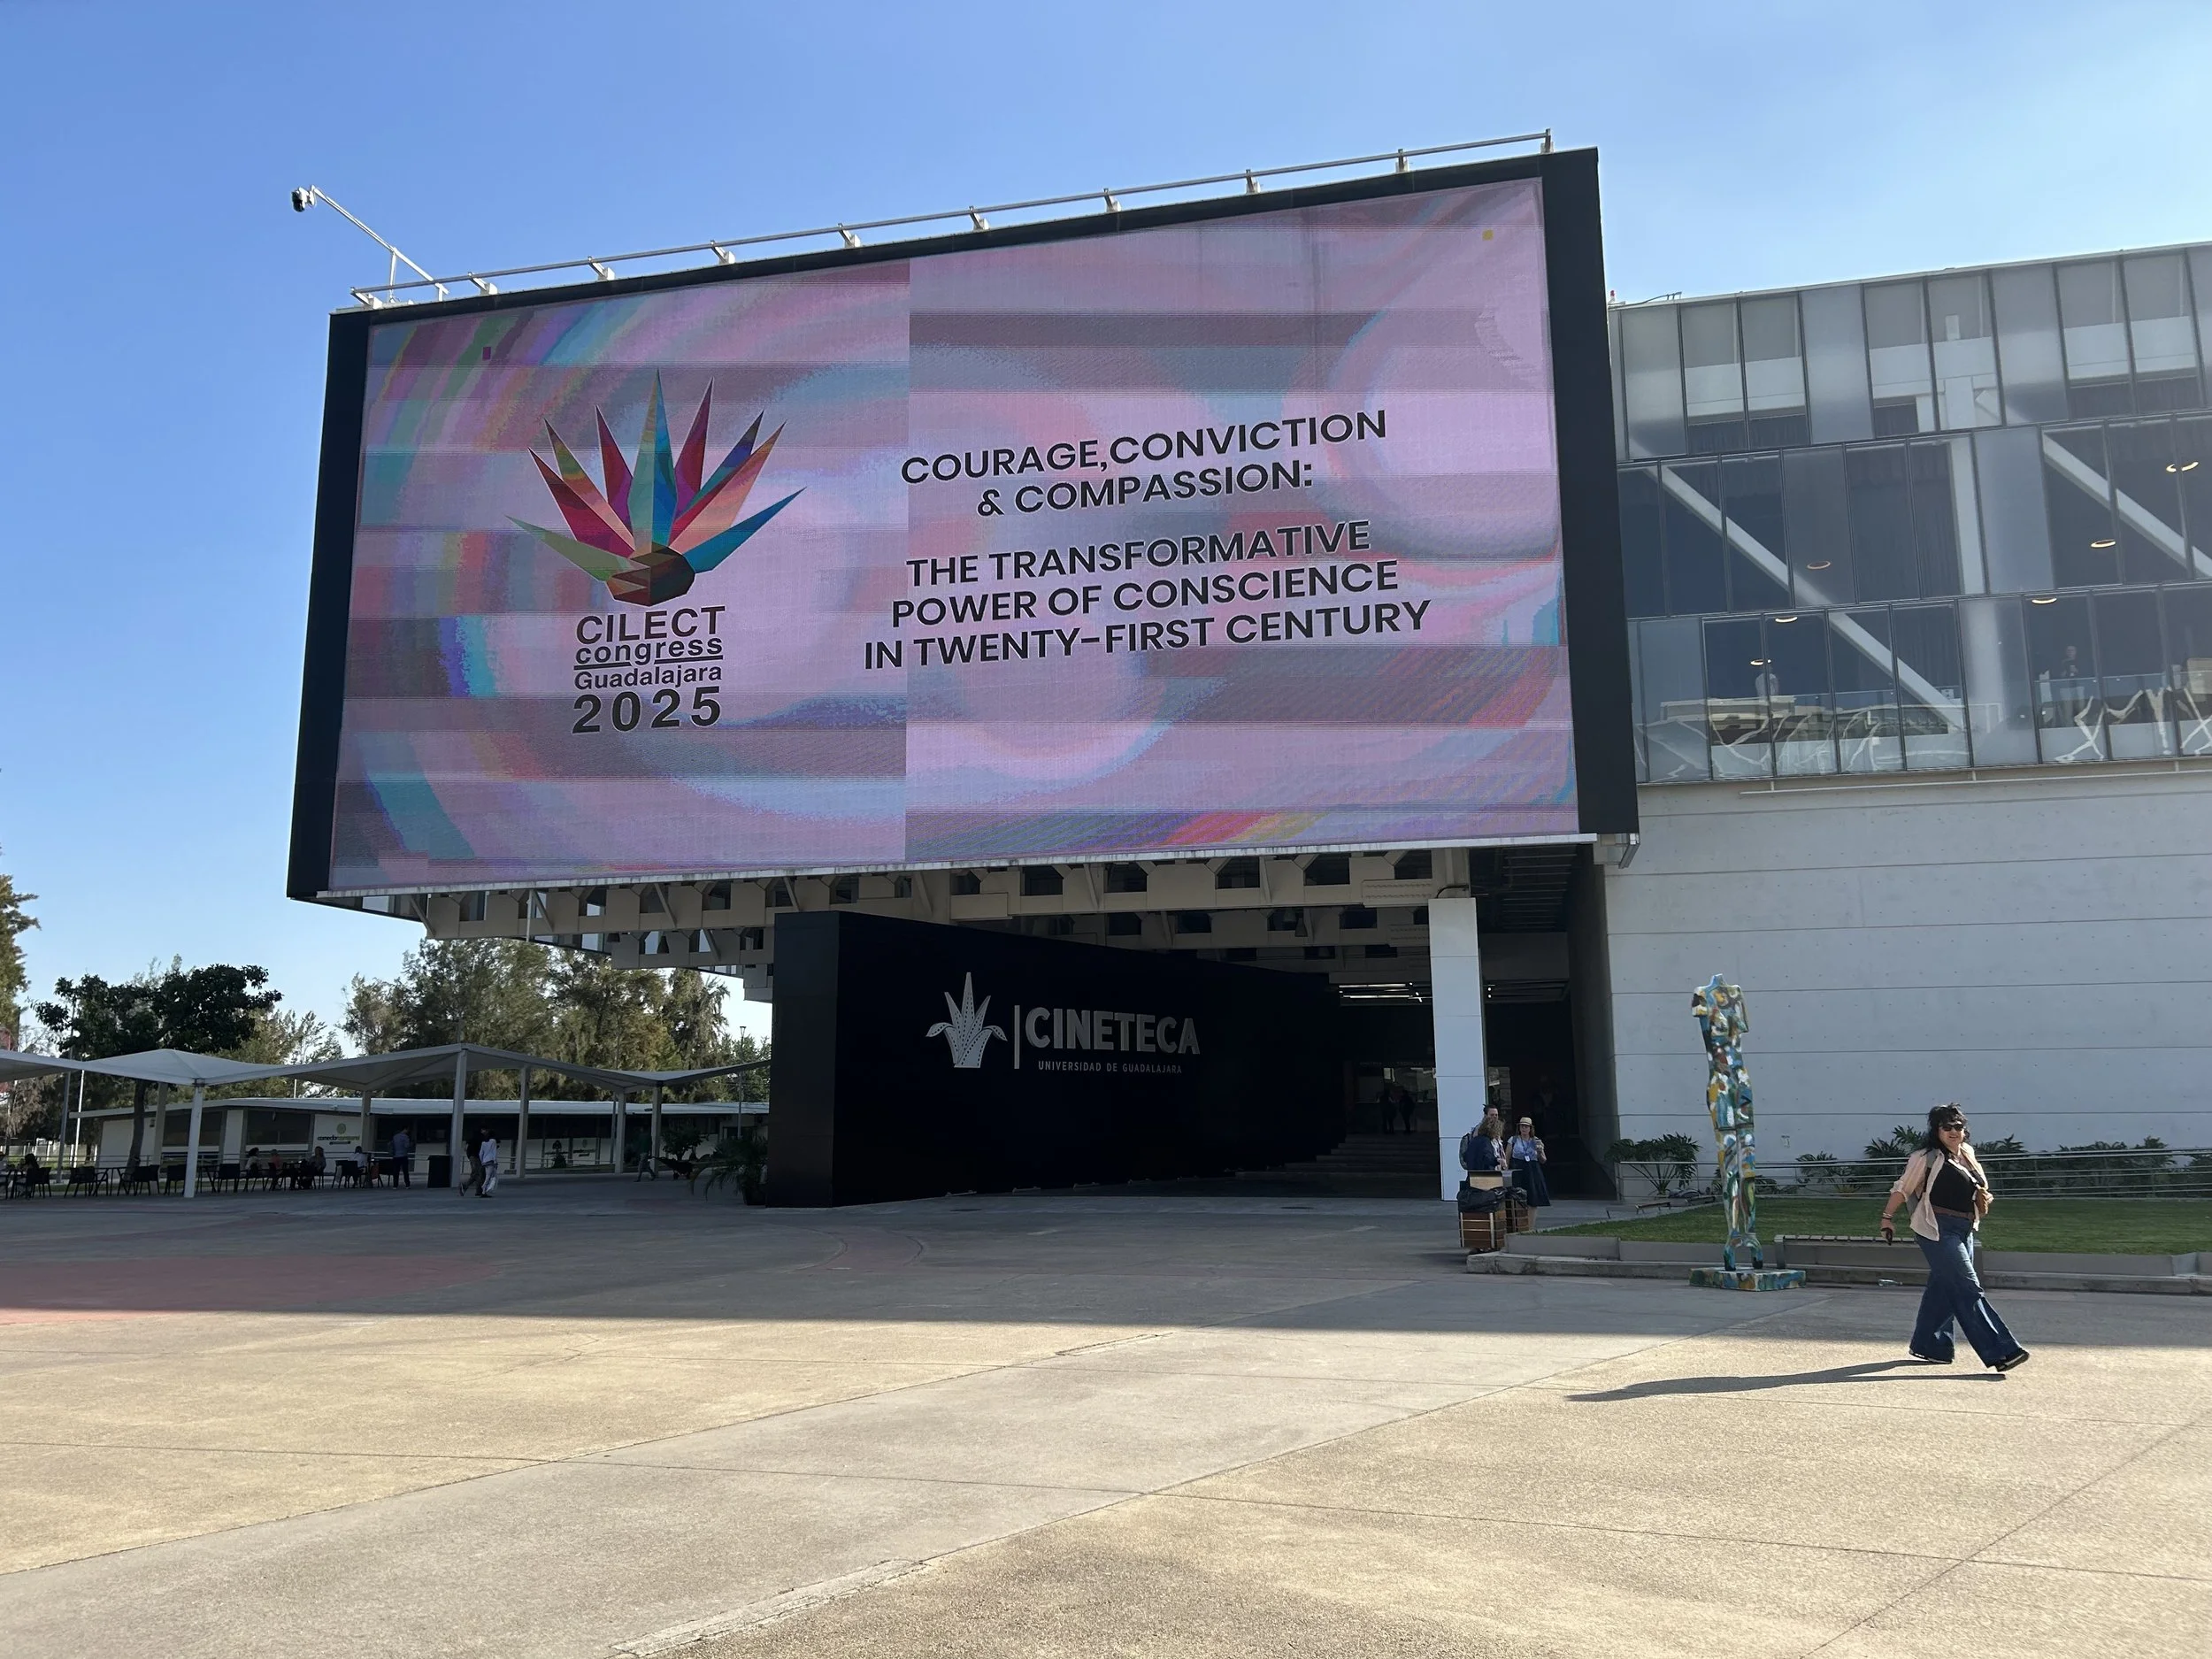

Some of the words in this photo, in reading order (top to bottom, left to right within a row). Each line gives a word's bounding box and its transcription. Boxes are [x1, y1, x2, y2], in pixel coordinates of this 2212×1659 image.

[977, 488, 1004, 517] &
[1015, 459, 1312, 514] COMPASSION:
[906, 555, 979, 587] THE
[988, 520, 1371, 580] TRANSFORMATIVE
[893, 590, 1037, 628] POWER
[1048, 585, 1102, 617] OF
[1113, 559, 1398, 611] CONSCIENCE
[576, 605, 726, 645] CILECT
[865, 640, 902, 670] IN
[913, 617, 1215, 666] TWENTY-FIRST
[1226, 599, 1432, 644] CENTURY
[575, 637, 723, 666] congress
[574, 665, 722, 690] Guadalajara
[572, 686, 721, 734] 2025
[1025, 1006, 1201, 1055] CINETECA
[1038, 1060, 1102, 1071] UNIVERSIDAD
[1106, 1063, 1118, 1072] DE
[1122, 1064, 1182, 1073] GUADALAJARA
